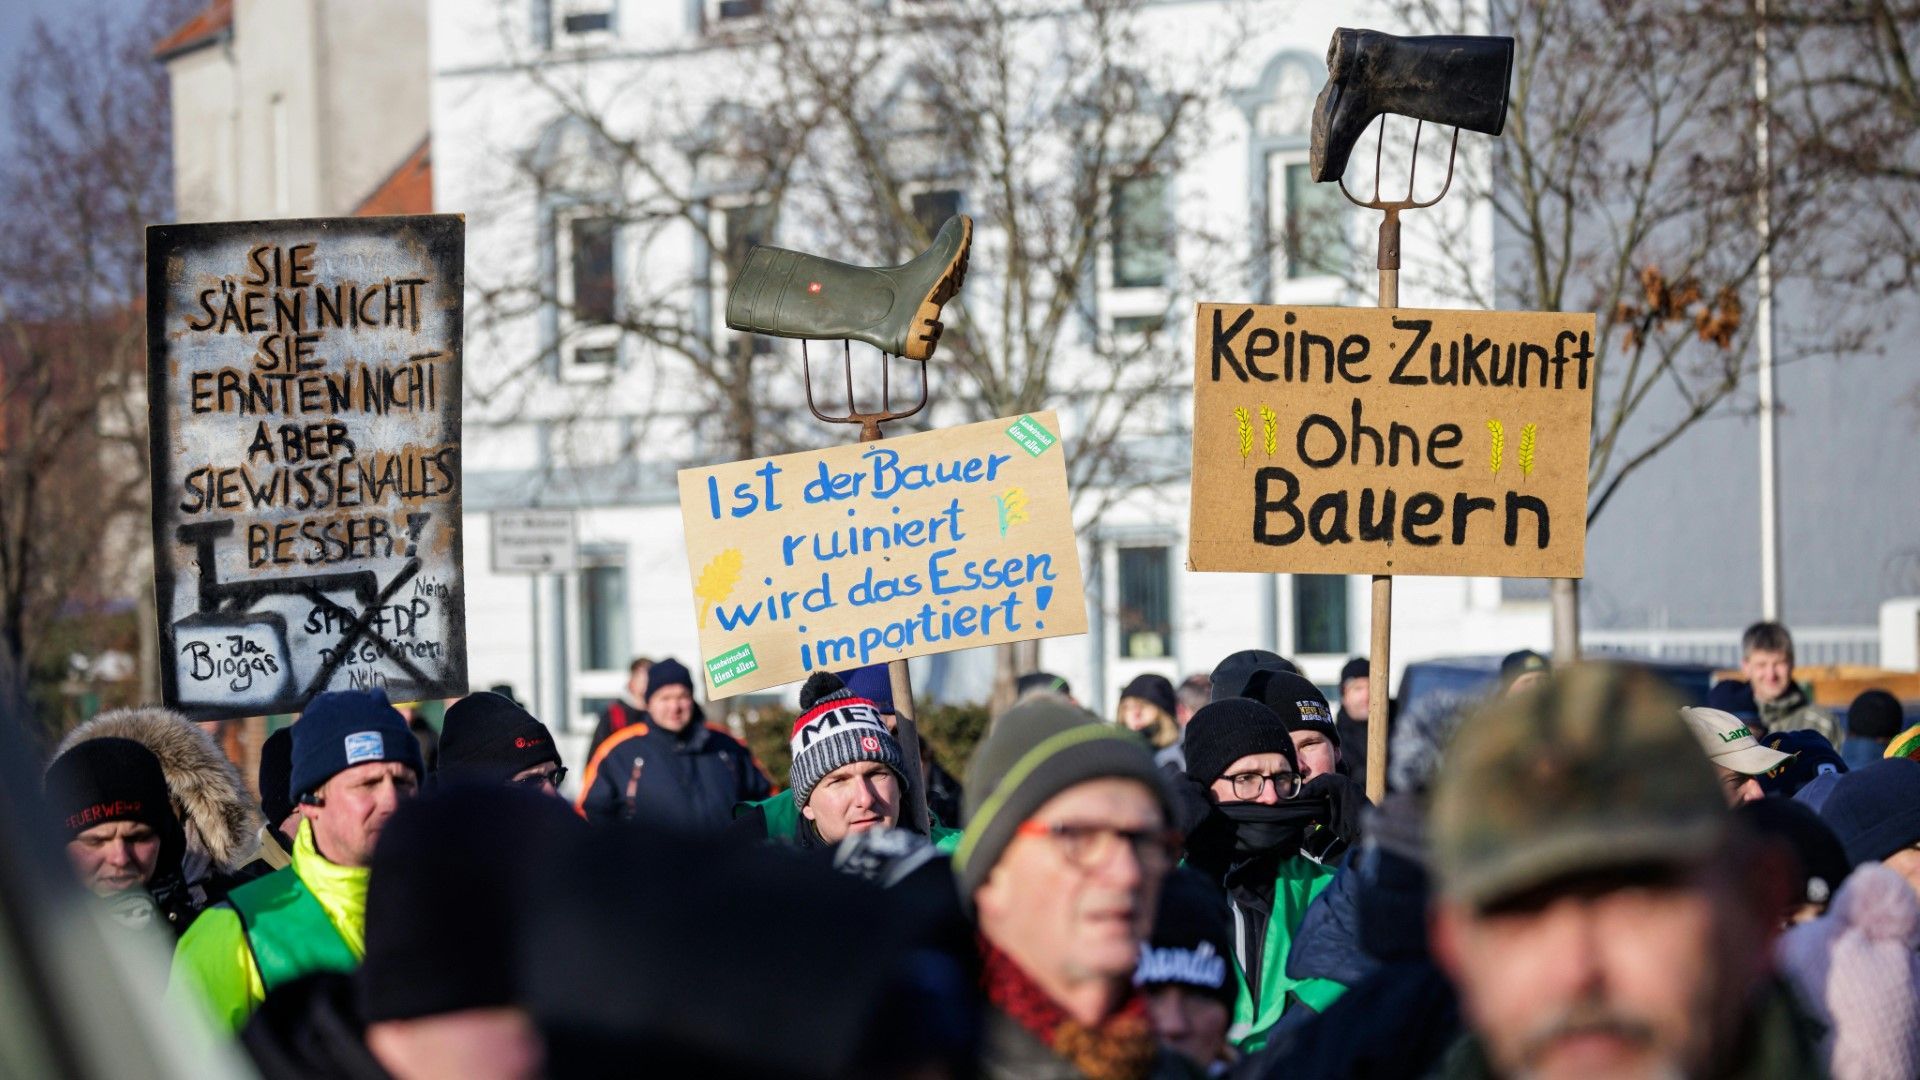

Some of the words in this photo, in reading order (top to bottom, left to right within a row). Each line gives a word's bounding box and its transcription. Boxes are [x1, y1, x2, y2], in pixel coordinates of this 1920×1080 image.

[246, 245, 311, 288] SIE
[190, 279, 299, 334] SÄEN
[316, 277, 429, 333] NICHT
[256, 333, 326, 372] SIE
[1211, 308, 1371, 384] Keine
[1388, 319, 1595, 390] Zukunft
[191, 371, 351, 417] ERNTEN
[361, 353, 442, 416] NICHT
[248, 421, 356, 464] ABER
[1296, 398, 1464, 469] ohne
[707, 461, 782, 520] Ist
[1253, 466, 1551, 550] Bauern
[247, 512, 431, 568] BESSER!
[782, 498, 966, 567] ruiniert
[715, 572, 838, 632] wird
[847, 566, 922, 607] das
[928, 548, 1058, 596] Essen
[799, 585, 1054, 672] importiert!
[708, 648, 750, 672] Landwirtschaft
[714, 667, 735, 684] dient
[735, 660, 756, 674] allen
